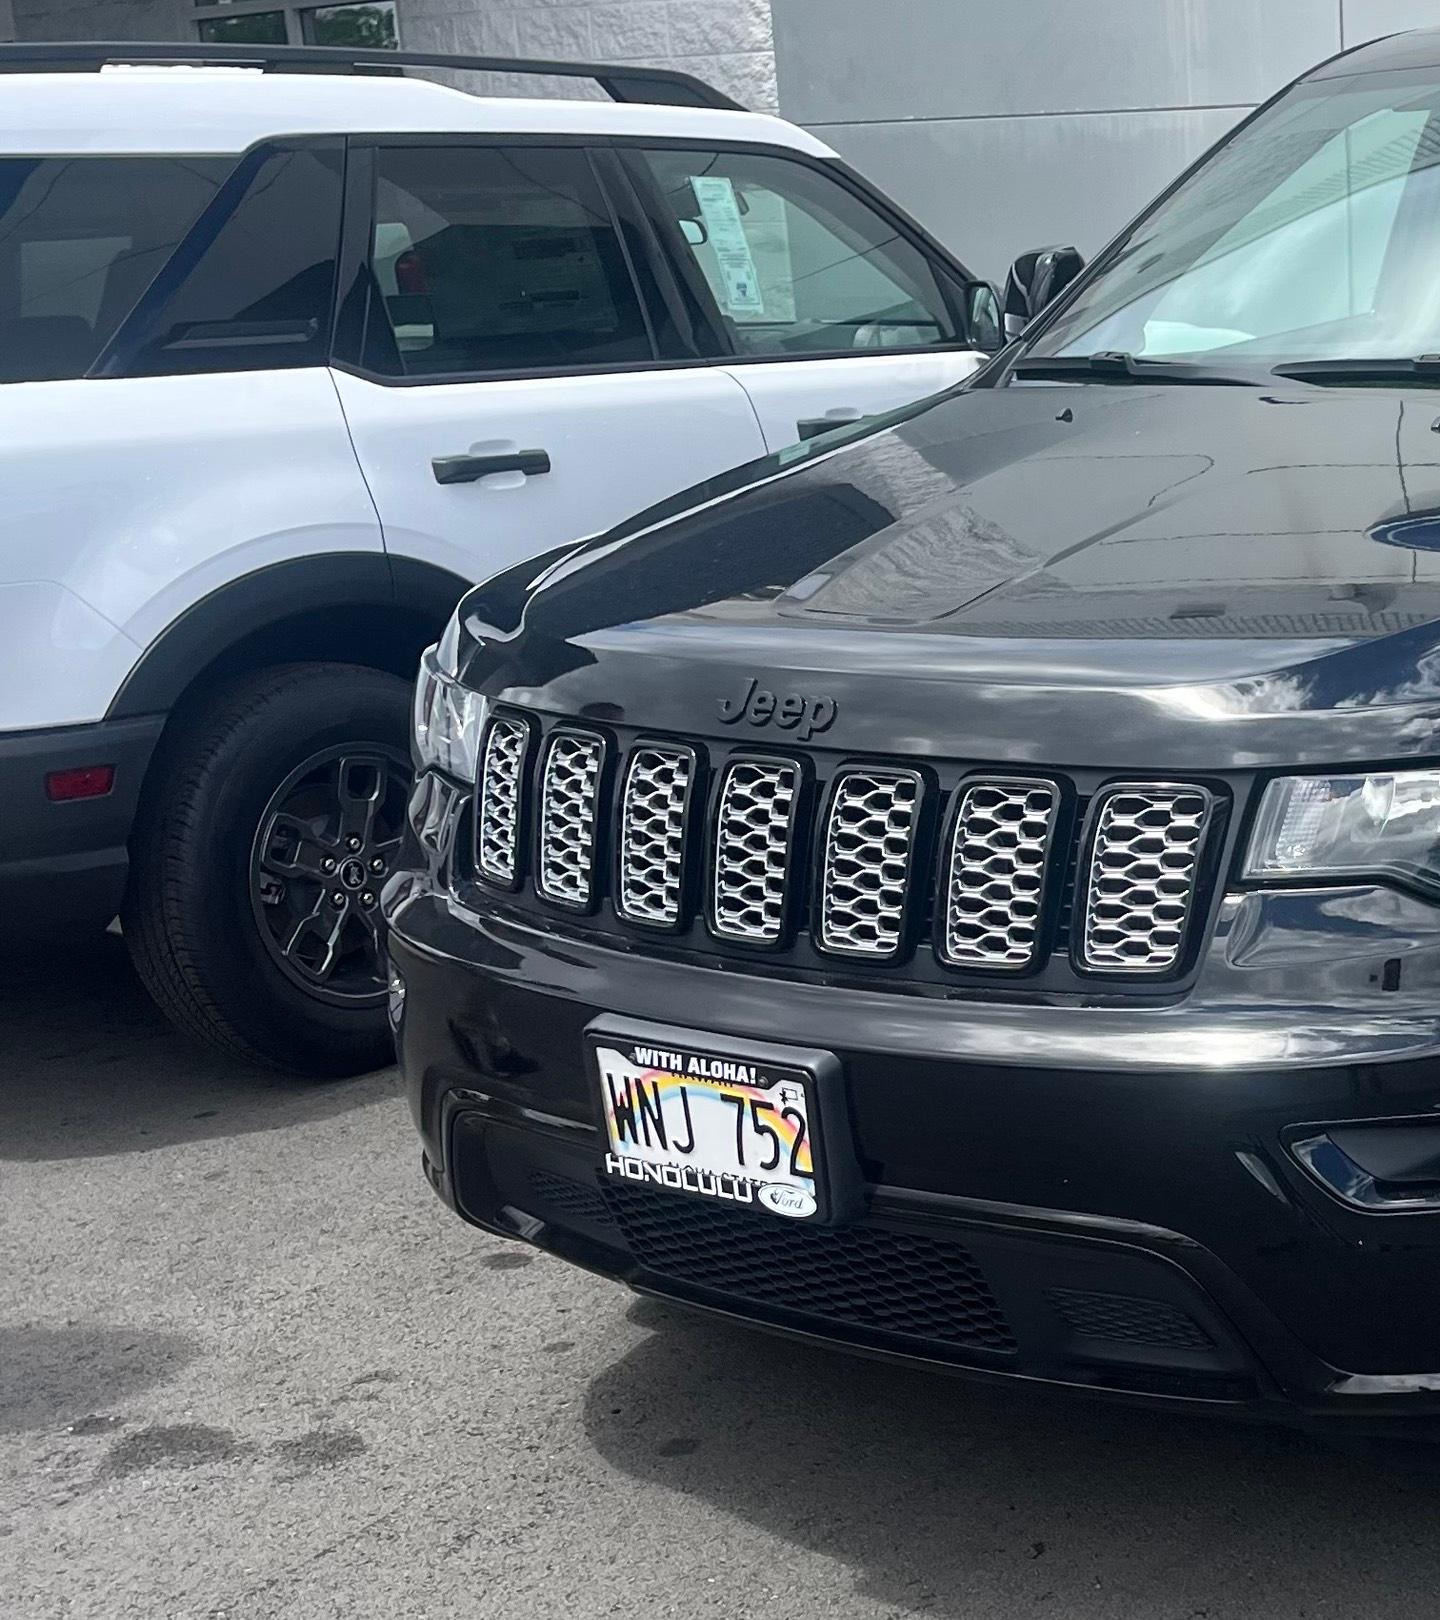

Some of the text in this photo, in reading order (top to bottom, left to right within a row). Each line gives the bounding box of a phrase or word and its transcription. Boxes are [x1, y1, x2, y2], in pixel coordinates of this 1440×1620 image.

[716, 677, 839, 742] Jeep
[634, 1046, 682, 1071] WITH
[688, 1060, 756, 1084] ALOHA!
[606, 1072, 815, 1179] WNJ 752
[605, 1152, 752, 1203] HONOLULU
